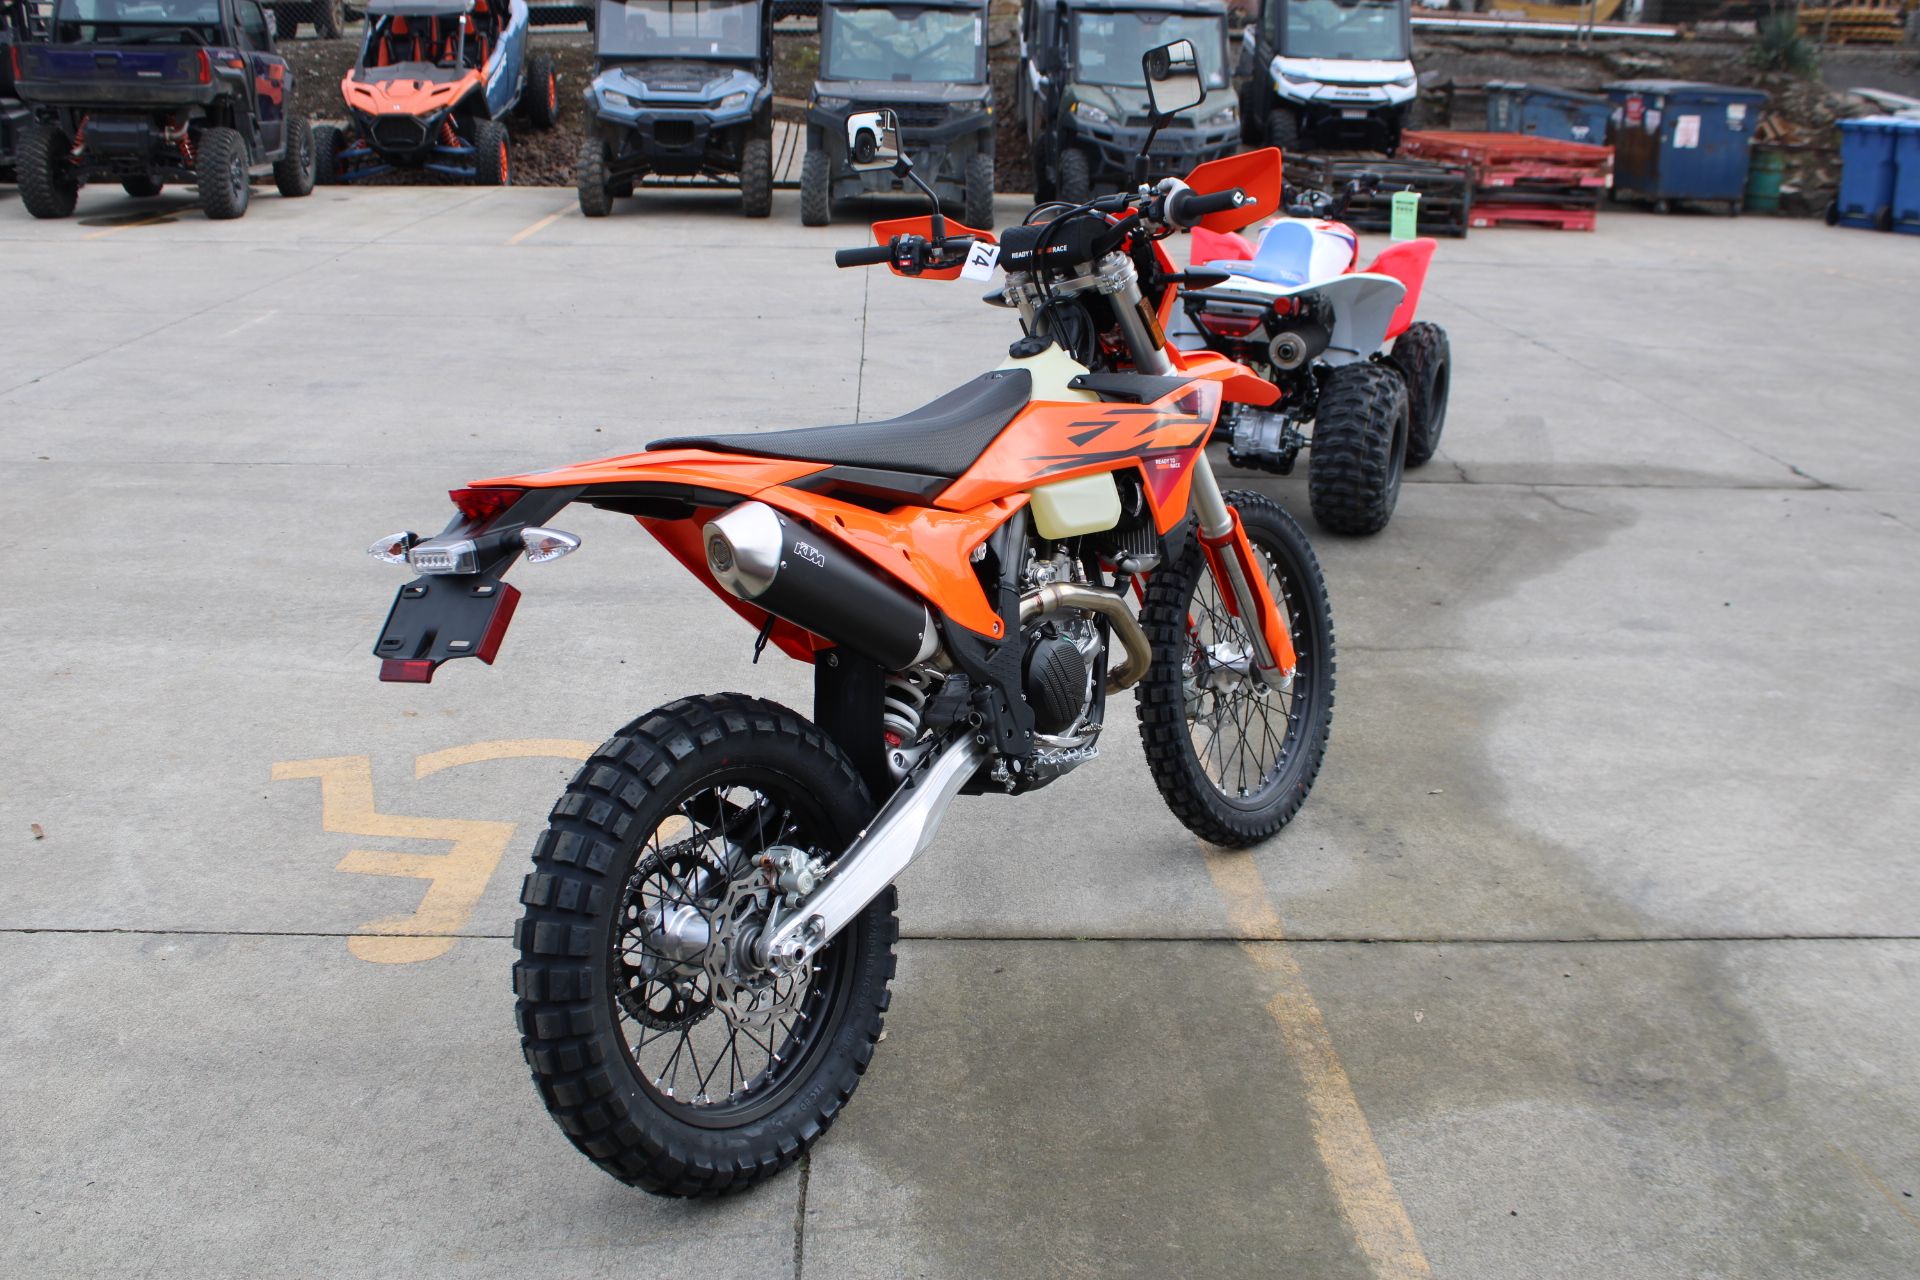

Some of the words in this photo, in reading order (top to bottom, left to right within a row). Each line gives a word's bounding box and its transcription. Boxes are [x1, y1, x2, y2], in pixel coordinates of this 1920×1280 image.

[971, 246, 995, 268] 74
[1011, 250, 1029, 259] READY
[1052, 244, 1068, 254] RACE
[793, 541, 825, 567] KTM
